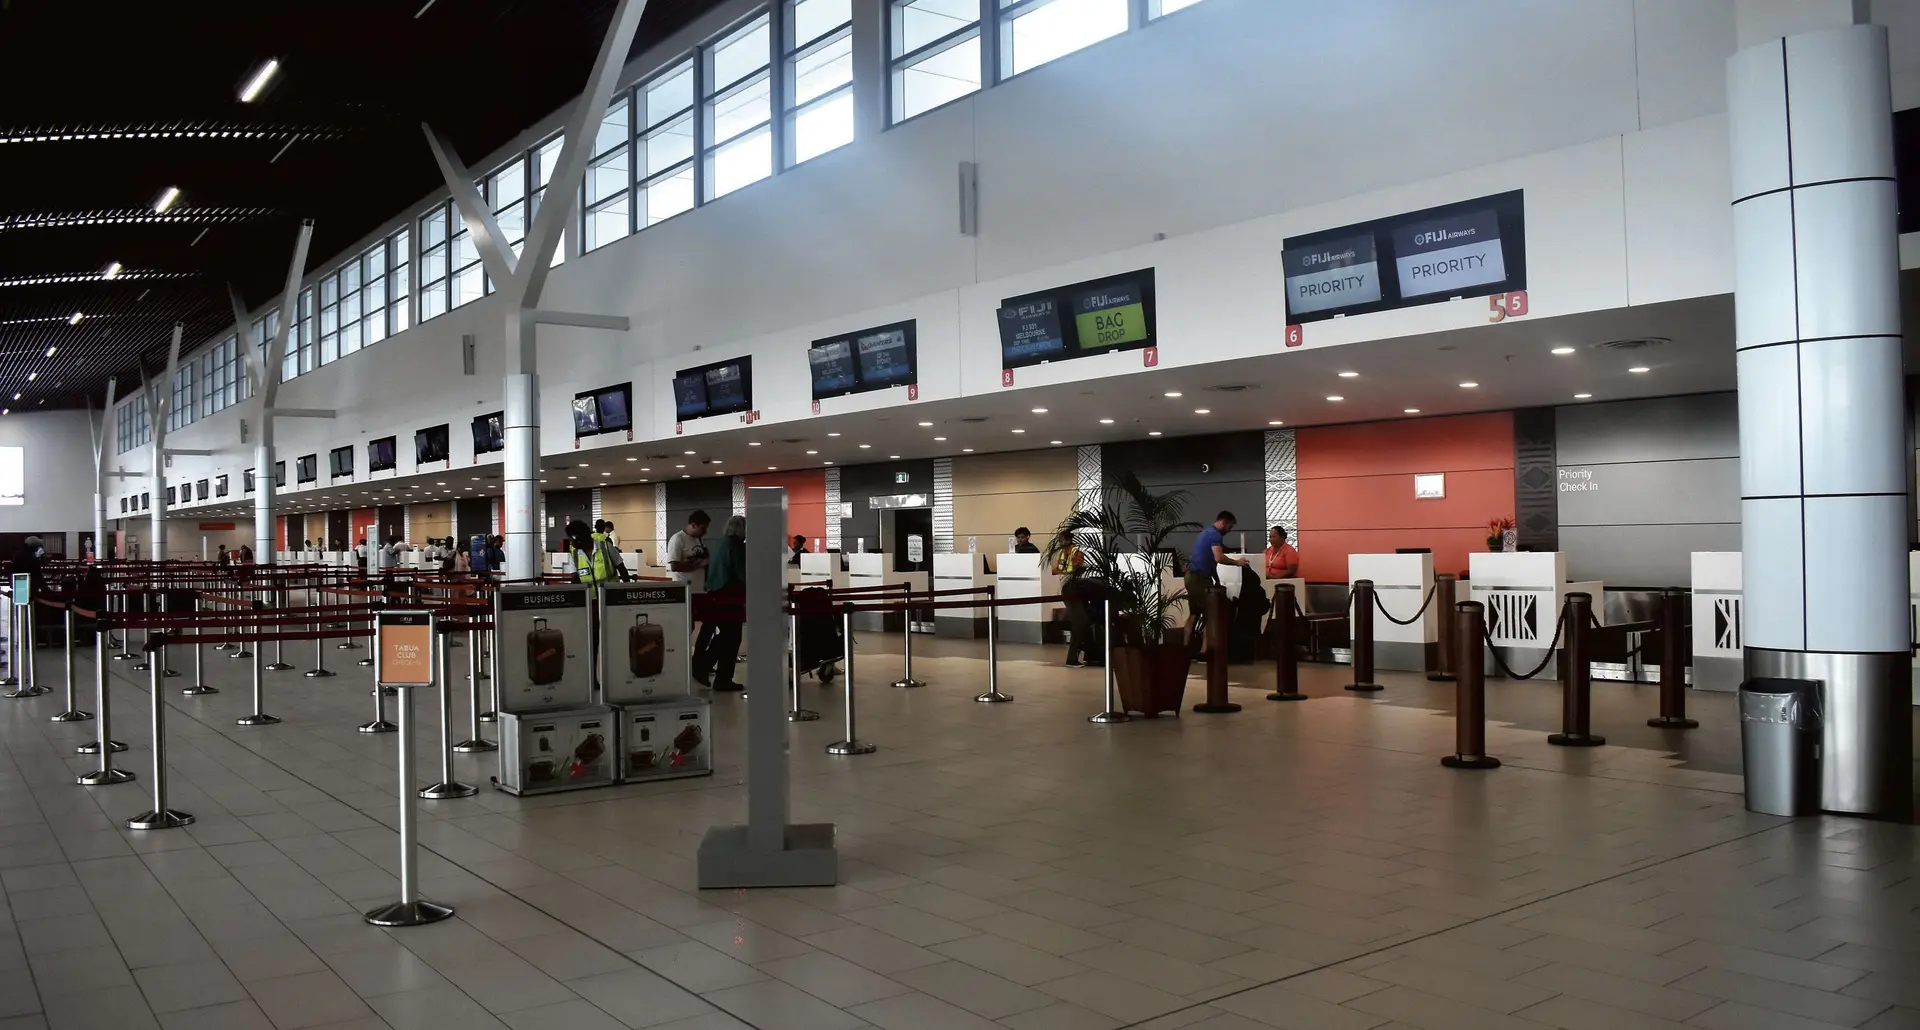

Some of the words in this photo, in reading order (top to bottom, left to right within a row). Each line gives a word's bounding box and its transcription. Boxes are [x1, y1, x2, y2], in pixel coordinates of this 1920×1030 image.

[1425, 229, 1447, 244] FIJI
[1448, 228, 1476, 240] AIRWAYS
[1311, 251, 1332, 265] FIJI
[1331, 250, 1356, 261] AIRWAYS
[1412, 254, 1486, 279] PRIORITY
[1300, 275, 1365, 298] PRIORITY
[1091, 294, 1108, 307] FIJI
[1512, 296, 1521, 310] 5
[1018, 302, 1052, 316] FIJI
[1489, 293, 1505, 322] 5
[1095, 312, 1124, 331] BAG
[1015, 328, 1046, 340] MELBOURNE
[1097, 329, 1126, 343] DROP
[1290, 330, 1298, 342] 6
[1147, 351, 1153, 363] 7
[1005, 372, 1011, 383] 8
[910, 388, 915, 397] 9
[812, 402, 819, 411] 10
[1559, 469, 1592, 480] Priority
[1560, 482, 1587, 491] Check
[1590, 481, 1598, 490] In
[524, 594, 565, 604] BUSINESS
[626, 590, 666, 600] BUSINESS
[393, 644, 420, 652] TABUA
